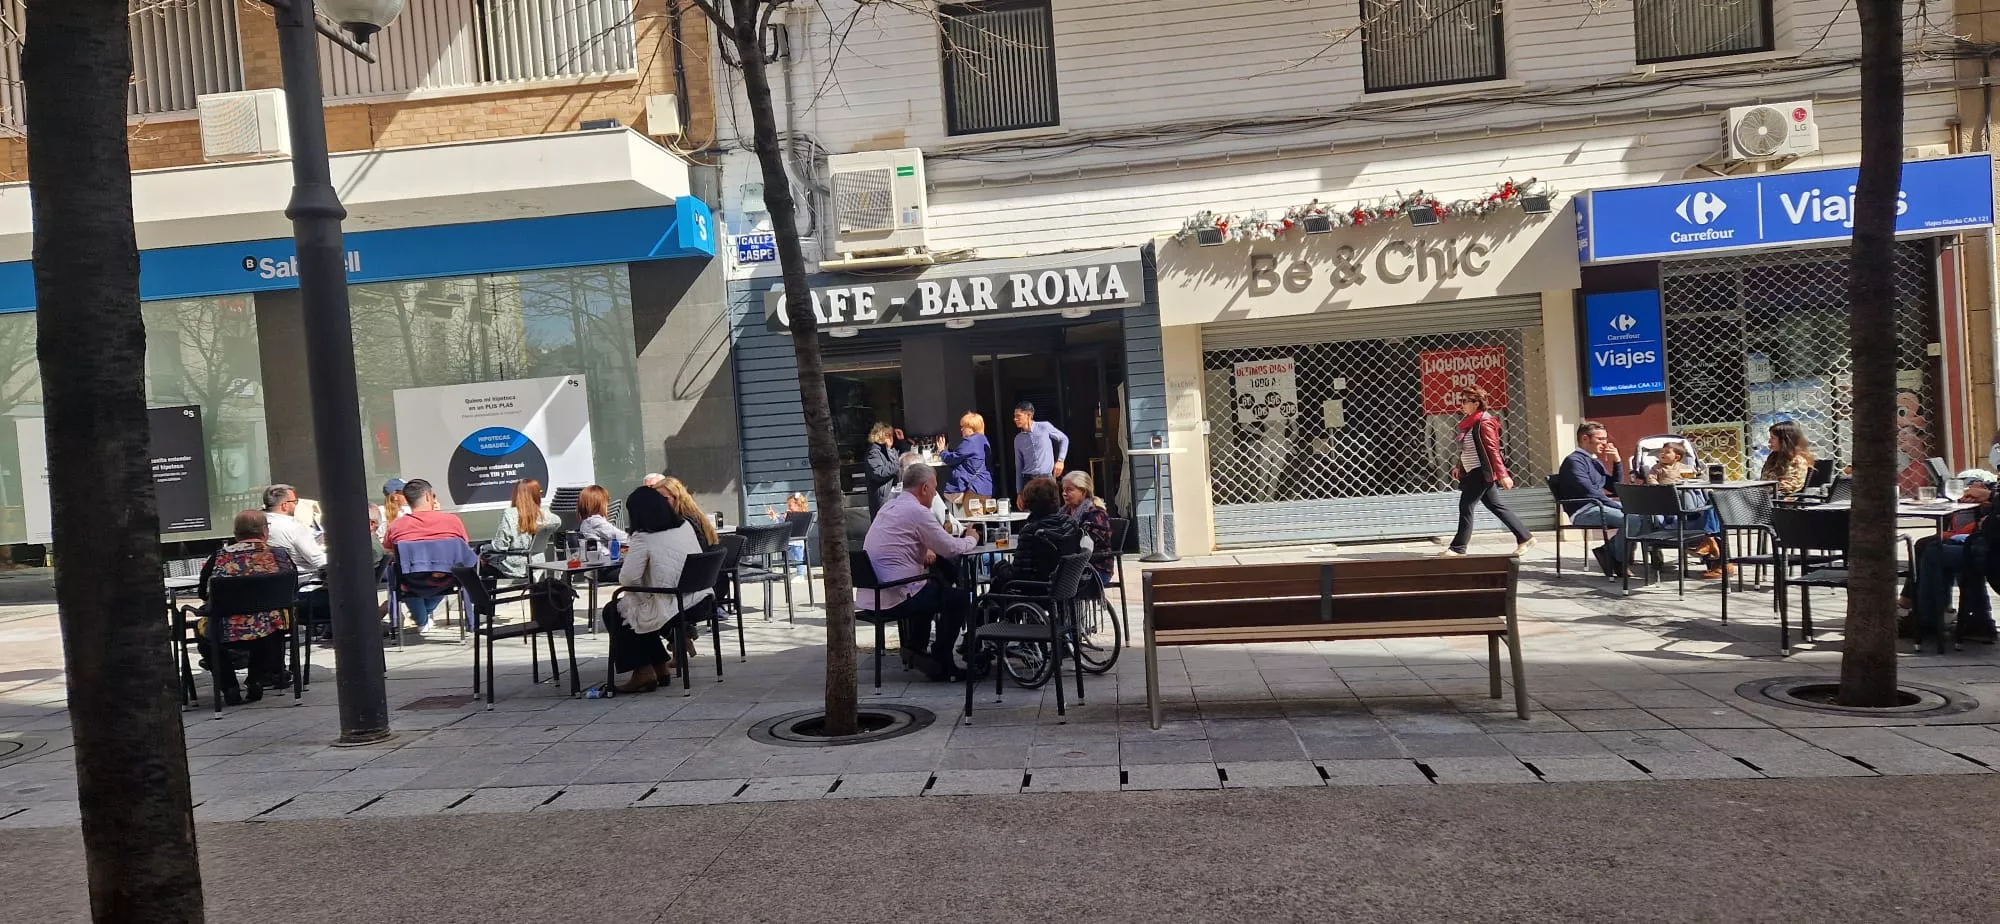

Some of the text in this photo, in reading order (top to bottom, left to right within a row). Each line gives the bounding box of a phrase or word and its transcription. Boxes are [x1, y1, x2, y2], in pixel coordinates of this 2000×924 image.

[1794, 123, 1807, 132] LG
[1779, 184, 1908, 228] Viajs
[741, 235, 771, 246] CALLE
[1670, 228, 1735, 244] Carrefour
[739, 249, 775, 262] CASPE
[259, 250, 361, 279] Sabll
[1249, 238, 1492, 298] Be & Chic
[918, 276, 998, 317] BAR
[1009, 264, 1129, 308] ROMA
[1607, 333, 1641, 341] Carrefour
[1595, 348, 1656, 369] Viajes
[1451, 374, 1476, 389] POR
